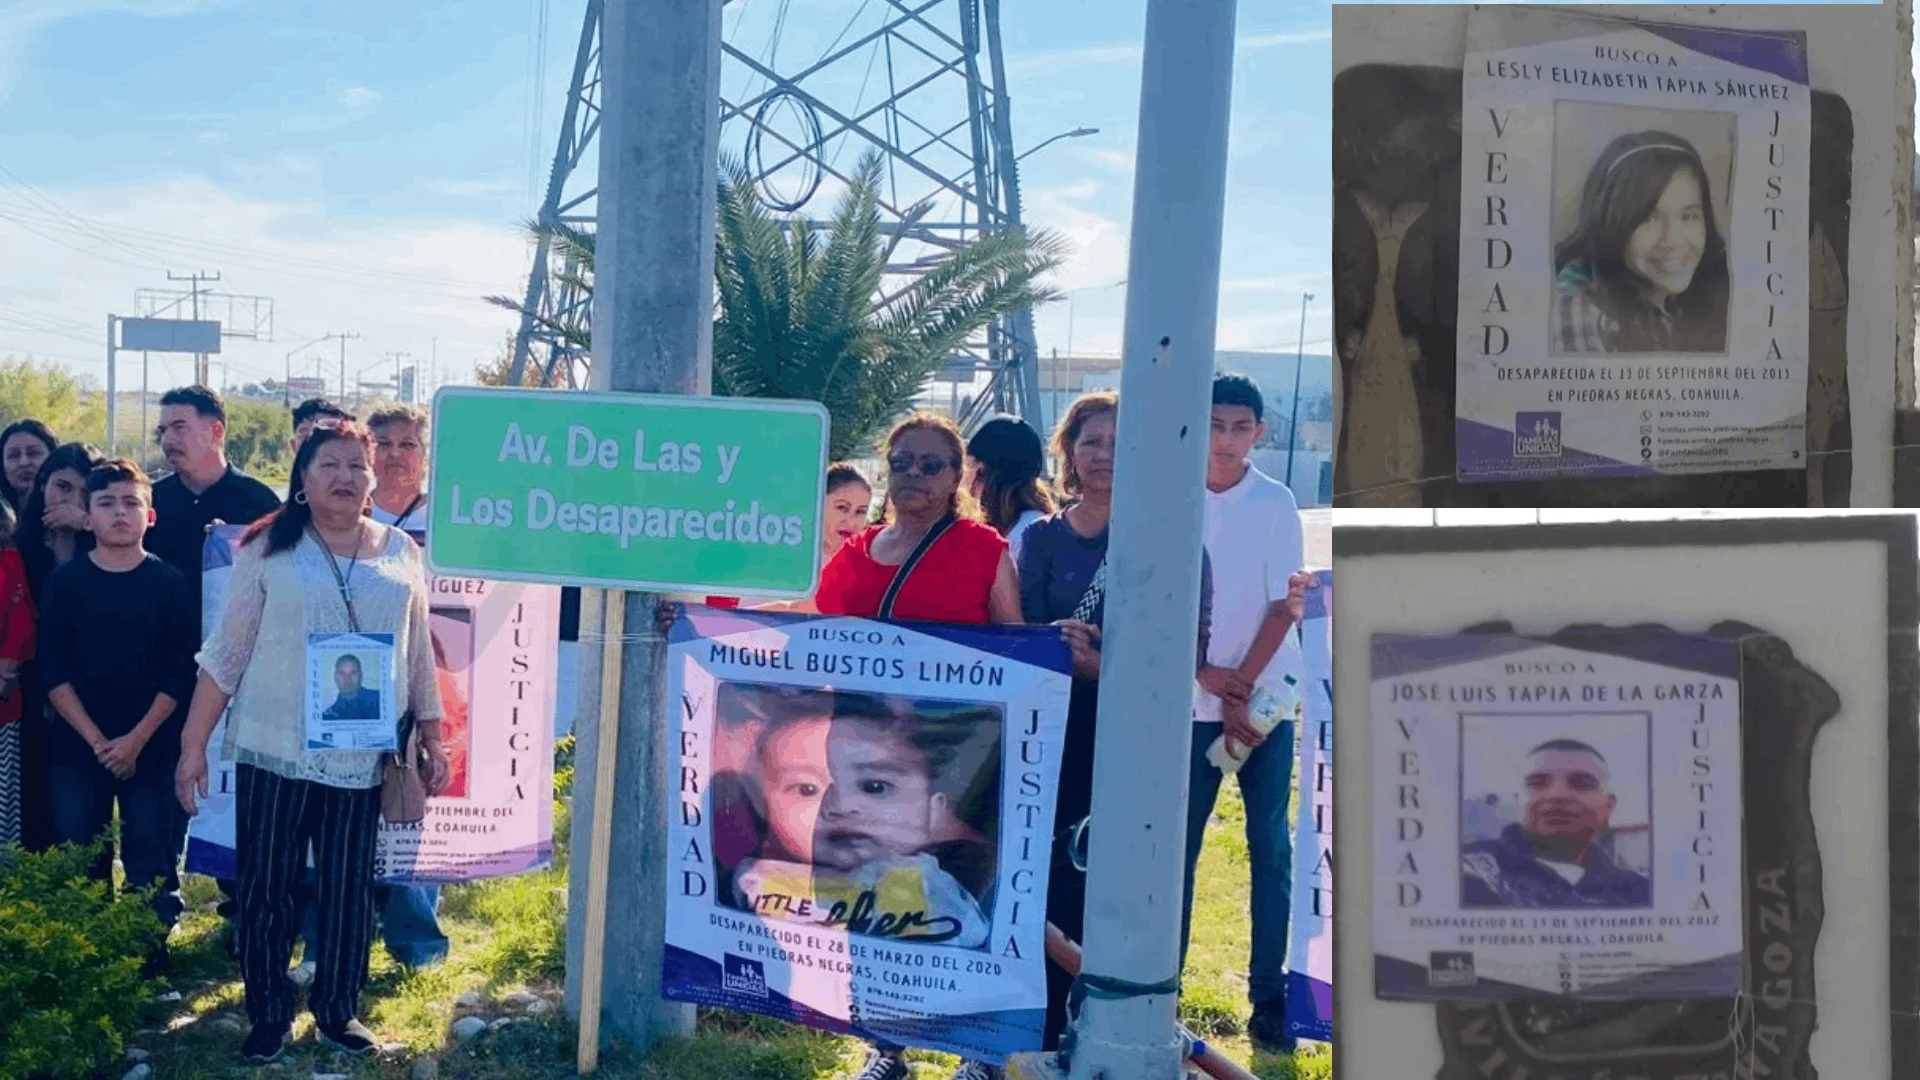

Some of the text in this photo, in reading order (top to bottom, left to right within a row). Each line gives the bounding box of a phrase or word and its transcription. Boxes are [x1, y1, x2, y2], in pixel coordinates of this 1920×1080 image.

[1595, 46, 1679, 67] BUSCO A
[1487, 60, 1790, 101] LESLY ELIZABETH TAPIA SÁNCHEZ
[1481, 108, 1513, 356] VERDAD
[1764, 109, 1785, 361] JUSTICIA
[1498, 367, 1791, 381] DESAPARECIDA EL 13 DE SEPTIEMBRE DEL 2013
[1548, 388, 1744, 402] EN PIEDRAS NEGRAS, COAHUILA.
[497, 422, 741, 486] Av. De Las y
[1517, 443, 1559, 454] UNIDAS
[450, 483, 803, 550] Los Desaparecidos
[430, 577, 486, 595] ÍGUEZ
[808, 627, 906, 647] BUSCO A
[710, 644, 1004, 687] MIGUEL BUSTOS LIMÓN
[1504, 662, 1598, 675] BUSCO A
[509, 602, 531, 800] JUSTICIA
[1450, 685, 1497, 702] LUIS
[1509, 685, 1571, 702] TAPIA
[1582, 685, 1608, 702] DE
[1618, 684, 1644, 701] LA
[1655, 683, 1724, 701] GARZA
[425, 805, 487, 818] PTIEMBRE
[680, 694, 707, 897] VERDAD
[1395, 718, 1424, 908] VERDAD
[1692, 703, 1713, 910] JUSTICIA
[1003, 709, 1045, 959] JUSTICIA
[1410, 916, 1507, 928] DESAPARECIDO
[1512, 916, 1525, 928] EL
[1552, 916, 1568, 928] DE
[1574, 916, 1652, 928] SEPTIEMBRE
[1659, 915, 1681, 926] DEL
[1688, 915, 1720, 926] 2012
[1459, 934, 1475, 945] EN
[1479, 934, 1535, 945] PIEDRAS
[710, 913, 1002, 976] DESAPARECIDO EL 28 DE MARZO DEL 2020
[738, 940, 962, 993] EN PIEDRAS NEGRAS, COAHUILA.
